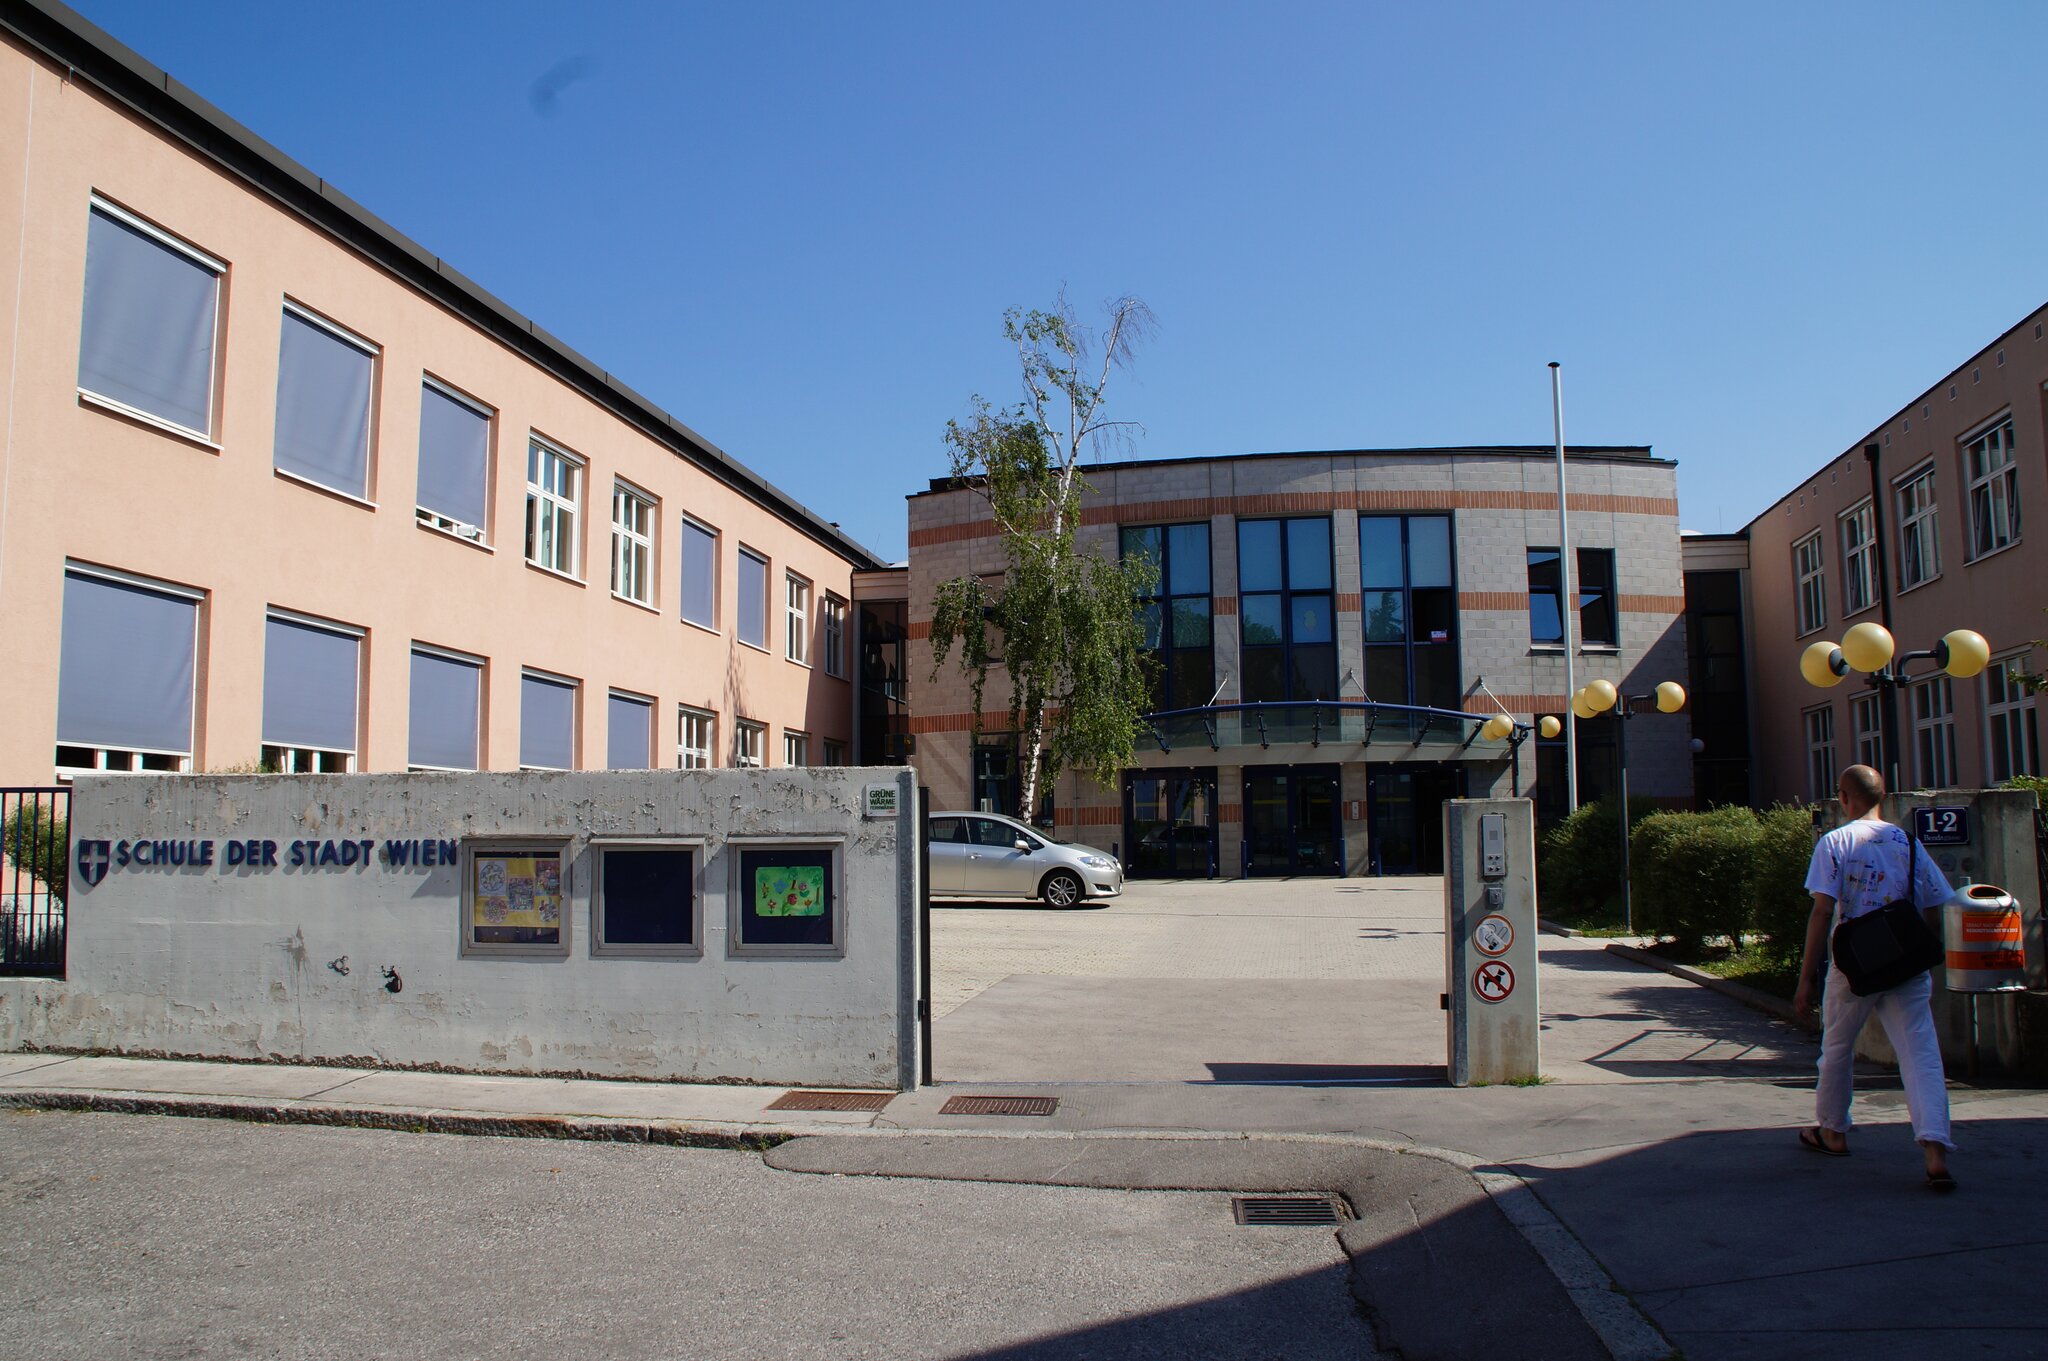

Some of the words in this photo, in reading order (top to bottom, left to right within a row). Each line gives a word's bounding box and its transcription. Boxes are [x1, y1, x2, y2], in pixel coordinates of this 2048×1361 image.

[869, 797, 896, 805] WÄRME
[870, 789, 896, 798] GRÜNE
[1925, 811, 1957, 832] 1-2
[116, 839, 214, 867] SCHULE
[227, 839, 278, 866] DER
[291, 839, 375, 866] STADT
[386, 838, 457, 866] WIEN
